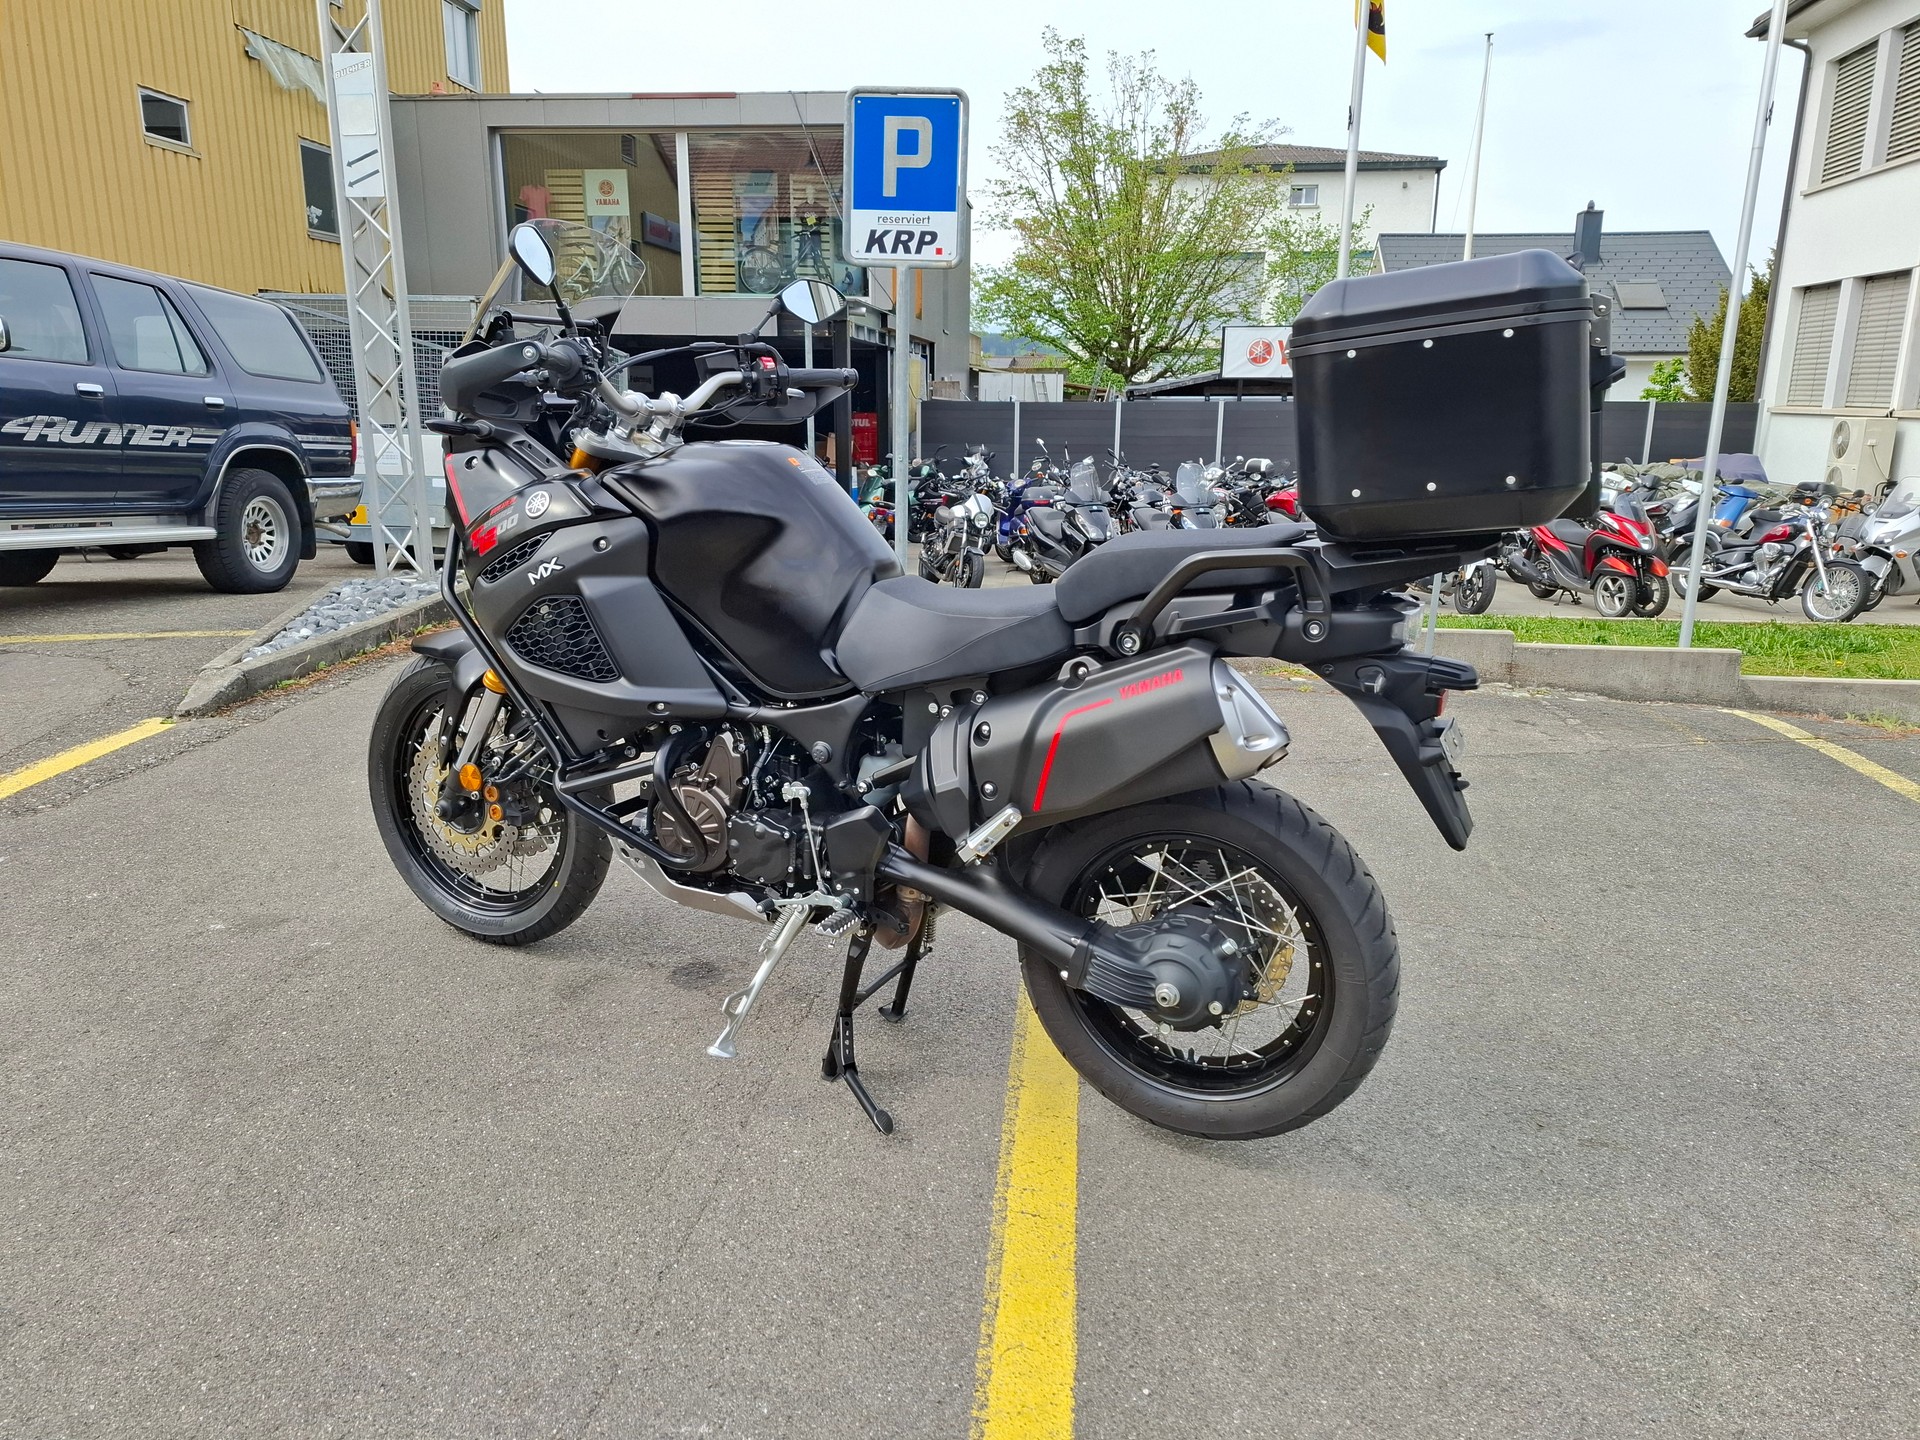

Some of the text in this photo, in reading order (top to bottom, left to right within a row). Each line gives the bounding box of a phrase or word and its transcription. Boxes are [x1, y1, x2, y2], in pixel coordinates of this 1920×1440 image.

[335, 59, 371, 79] BUCHER
[883, 116, 933, 197] P
[595, 198, 620, 206] YAMAHA
[877, 214, 931, 225] reserviert
[851, 418, 870, 427] TUL
[527, 557, 564, 585] MX
[1119, 668, 1183, 700] YAMAHA
